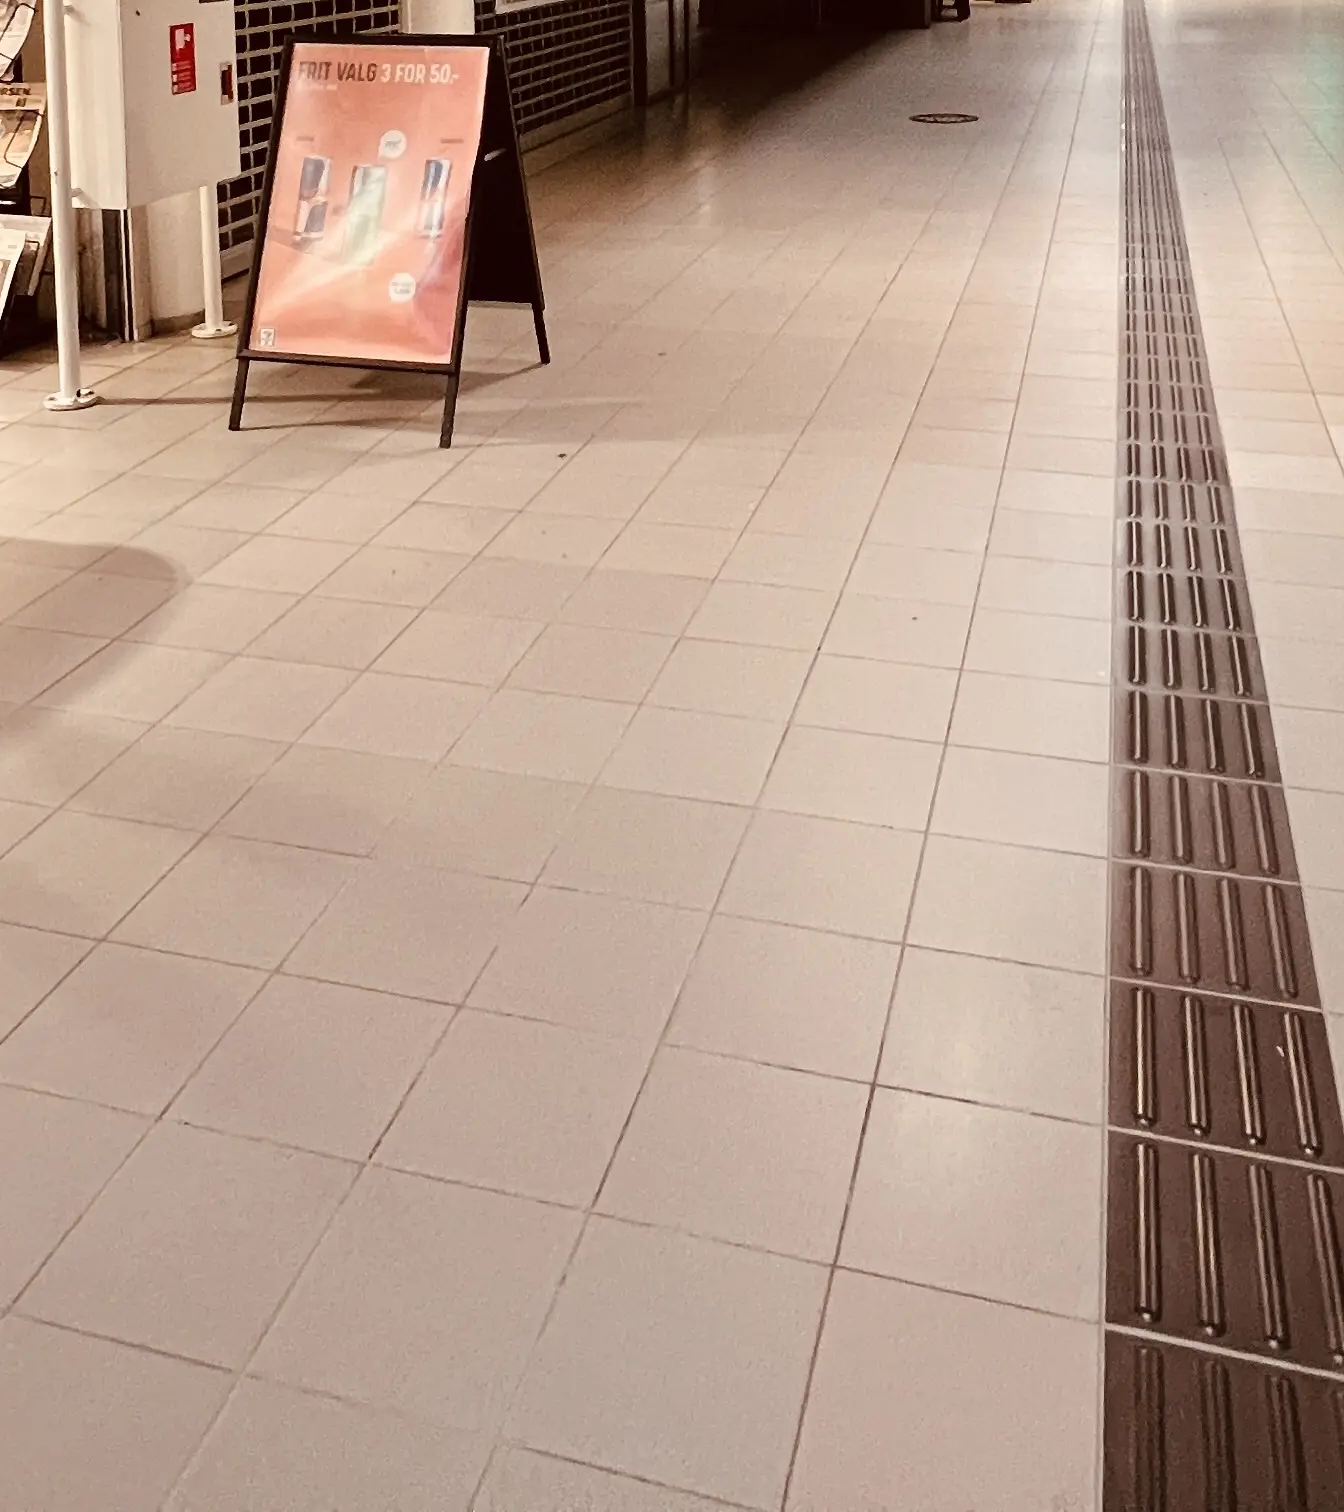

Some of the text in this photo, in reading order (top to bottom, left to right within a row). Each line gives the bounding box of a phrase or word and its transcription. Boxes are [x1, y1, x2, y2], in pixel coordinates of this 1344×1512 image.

[298, 60, 333, 81] FRIT
[336, 61, 378, 82] VALG
[380, 63, 392, 83] 3
[394, 63, 426, 84] FOR
